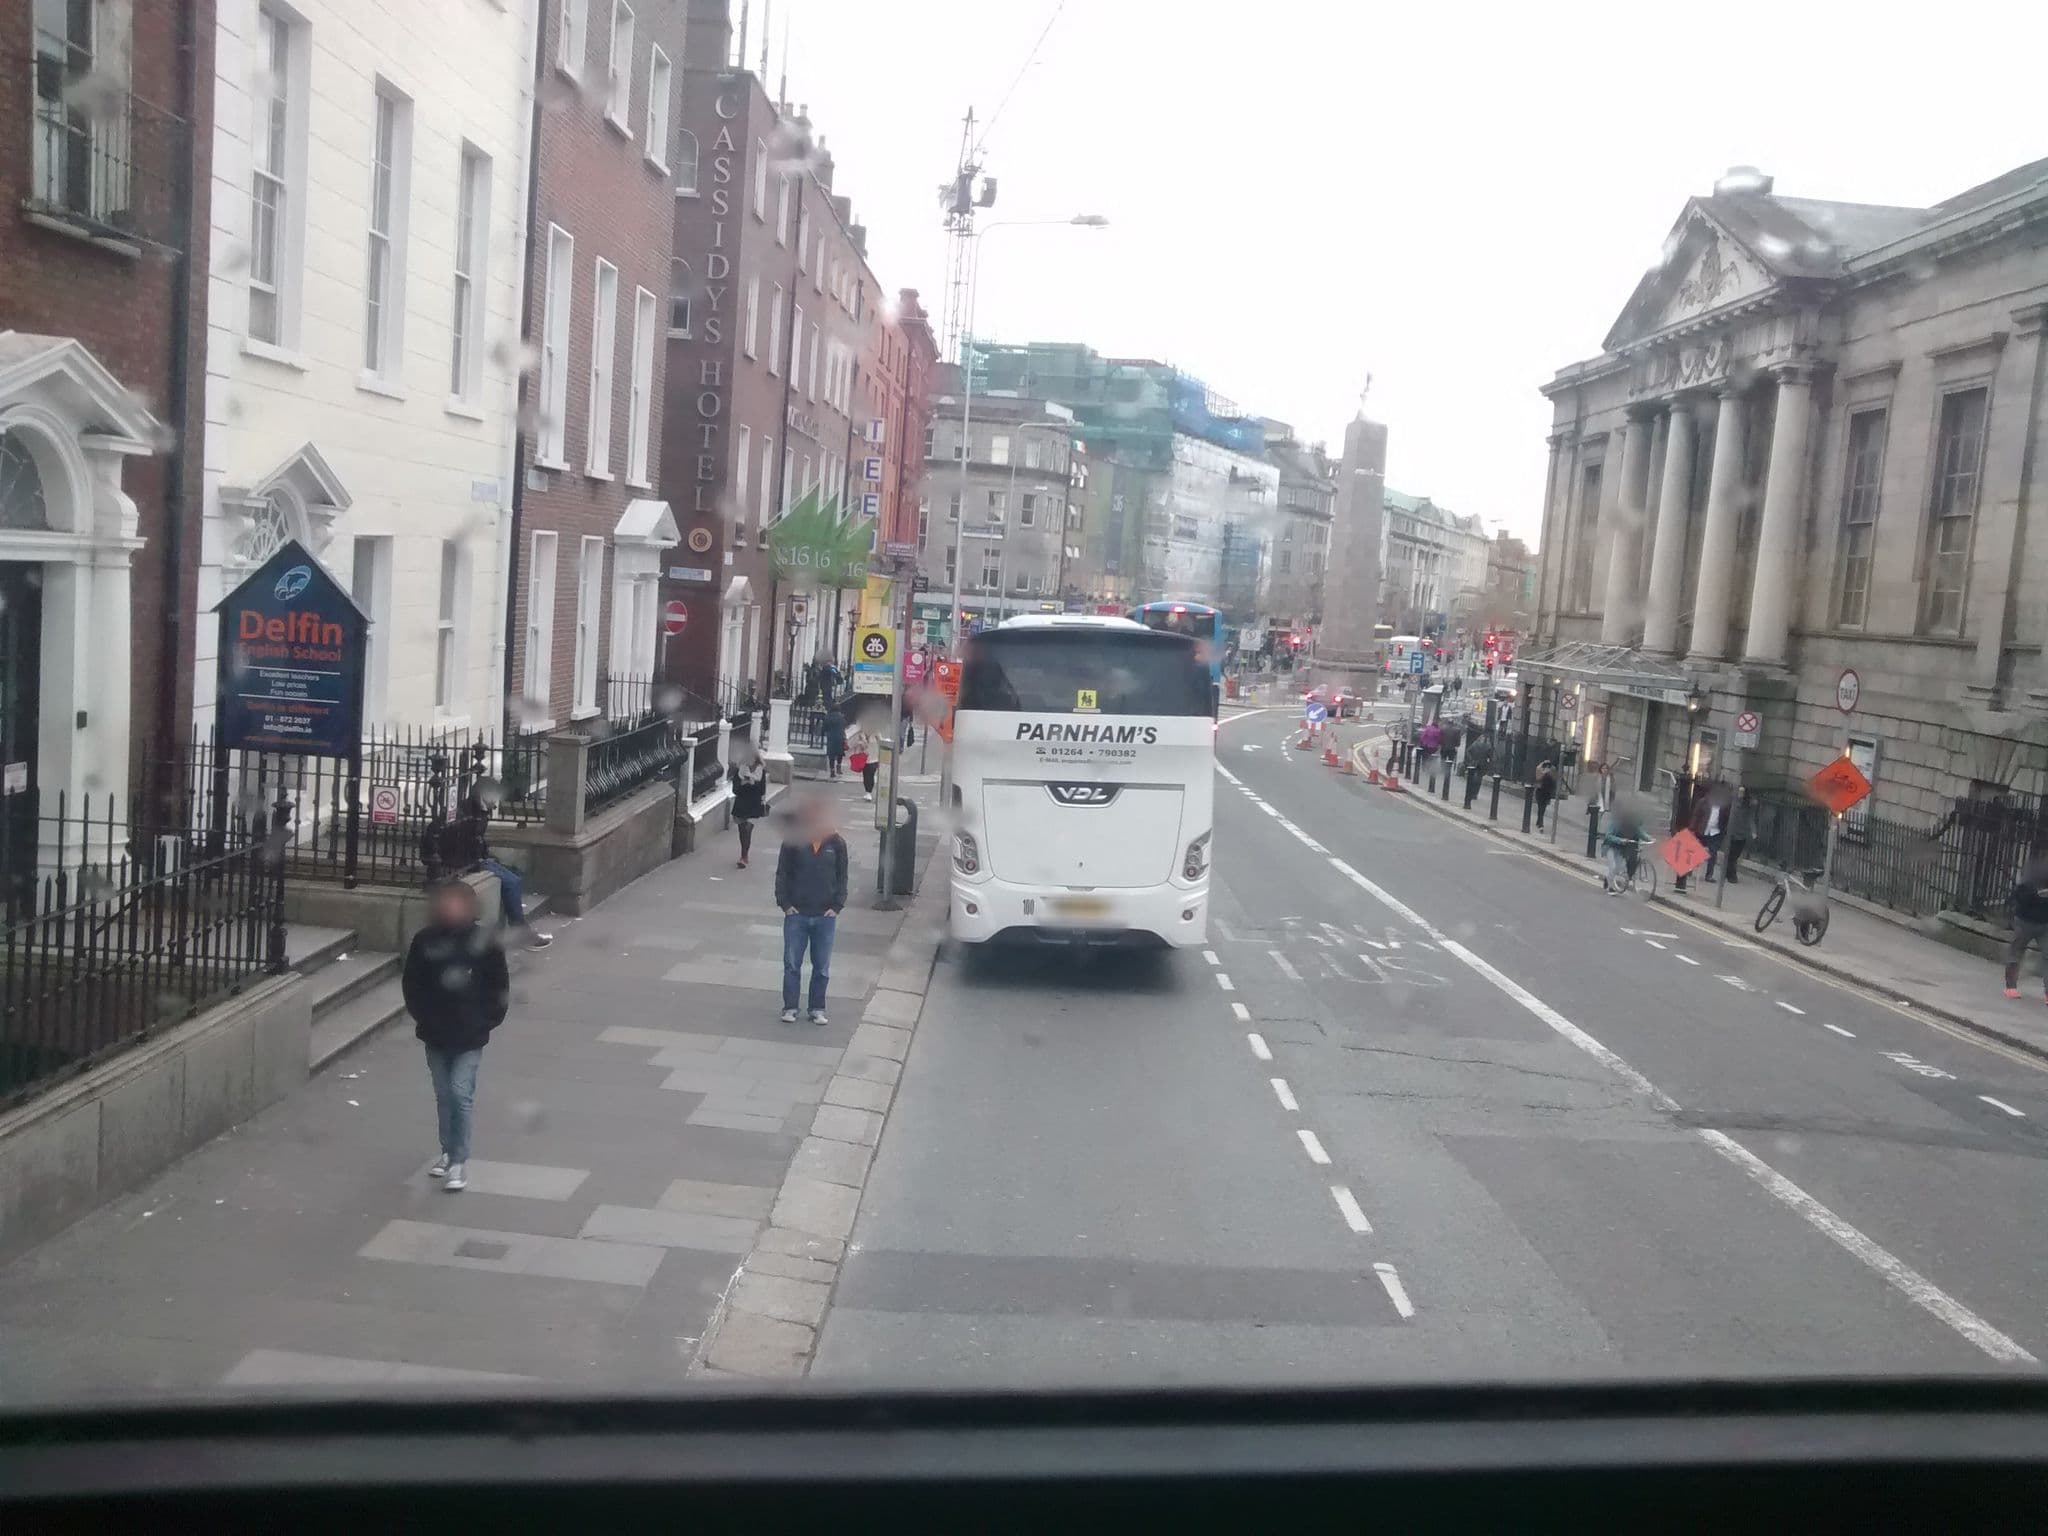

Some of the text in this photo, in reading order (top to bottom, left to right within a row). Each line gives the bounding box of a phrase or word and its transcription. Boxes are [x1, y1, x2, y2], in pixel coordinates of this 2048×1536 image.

[695, 95, 737, 512] CASSIDYS HOTEL
[240, 609, 343, 645] Delfin
[293, 646, 341, 661] School
[1016, 723, 1157, 744] PARNHAM'S
[1051, 748, 1137, 758] 01264 790382
[1057, 786, 1108, 800] VDL
